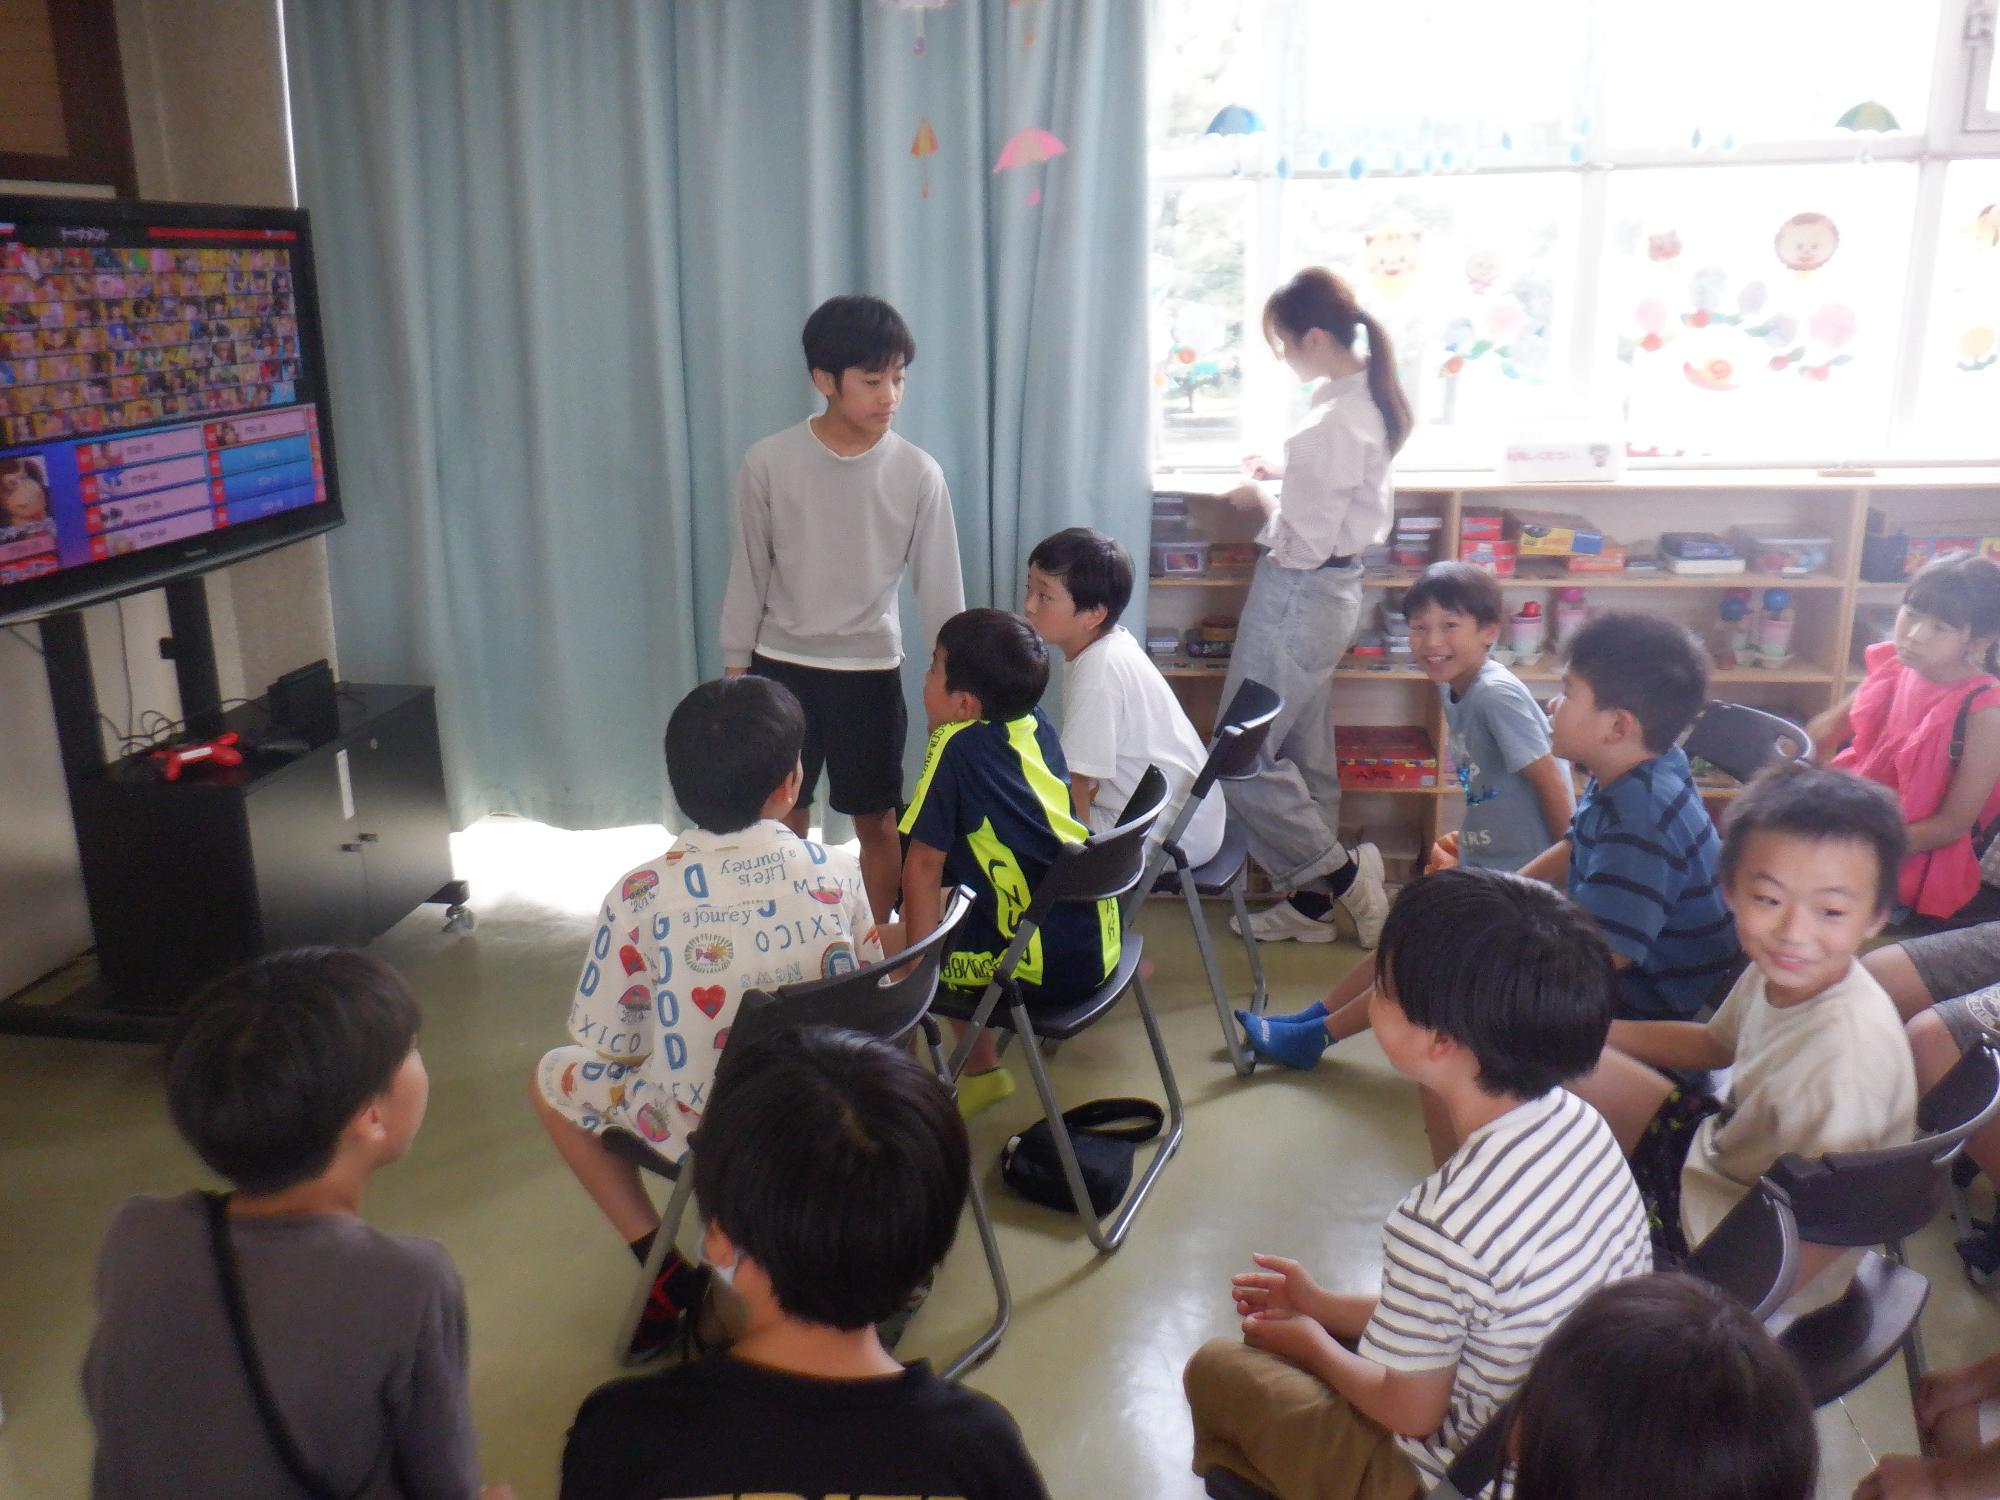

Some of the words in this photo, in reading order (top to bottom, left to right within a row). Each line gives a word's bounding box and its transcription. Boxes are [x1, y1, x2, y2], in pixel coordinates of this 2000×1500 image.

[721, 846, 786, 874] journey
[738, 873, 751, 887] is
[753, 864, 786, 885] Life
[692, 907, 753, 928] jourey
